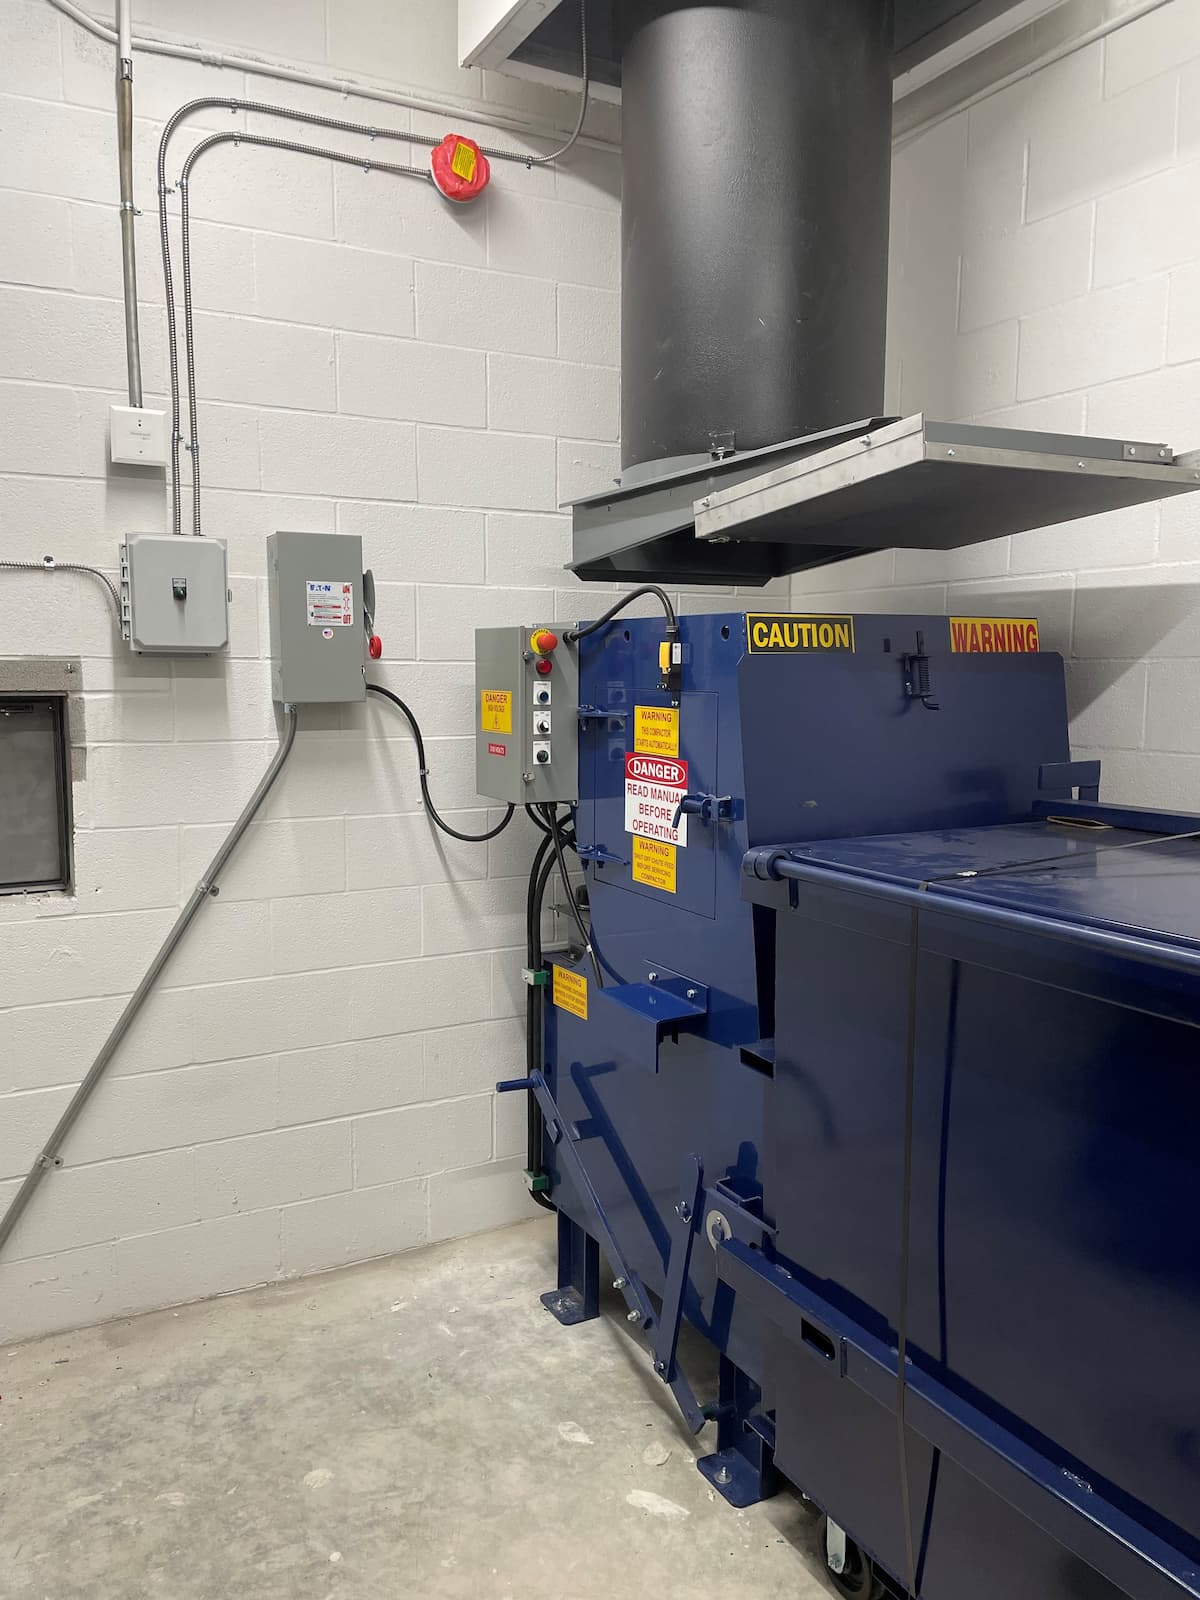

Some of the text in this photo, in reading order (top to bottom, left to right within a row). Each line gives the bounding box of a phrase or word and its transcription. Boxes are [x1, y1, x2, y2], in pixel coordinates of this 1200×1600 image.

[752, 622, 850, 648] CAUTION
[951, 622, 1038, 652] WARNING
[486, 694, 508, 704] DANGER
[641, 711, 672, 722] WARNING
[633, 760, 679, 781] DANGER
[627, 784, 648, 798] READ
[639, 804, 672, 820] BEFORE
[632, 819, 678, 840] OPERATING
[639, 840, 670, 856] WARNING
[640, 872, 666, 884] COMPACTOR
[558, 971, 582, 988] WARNING
